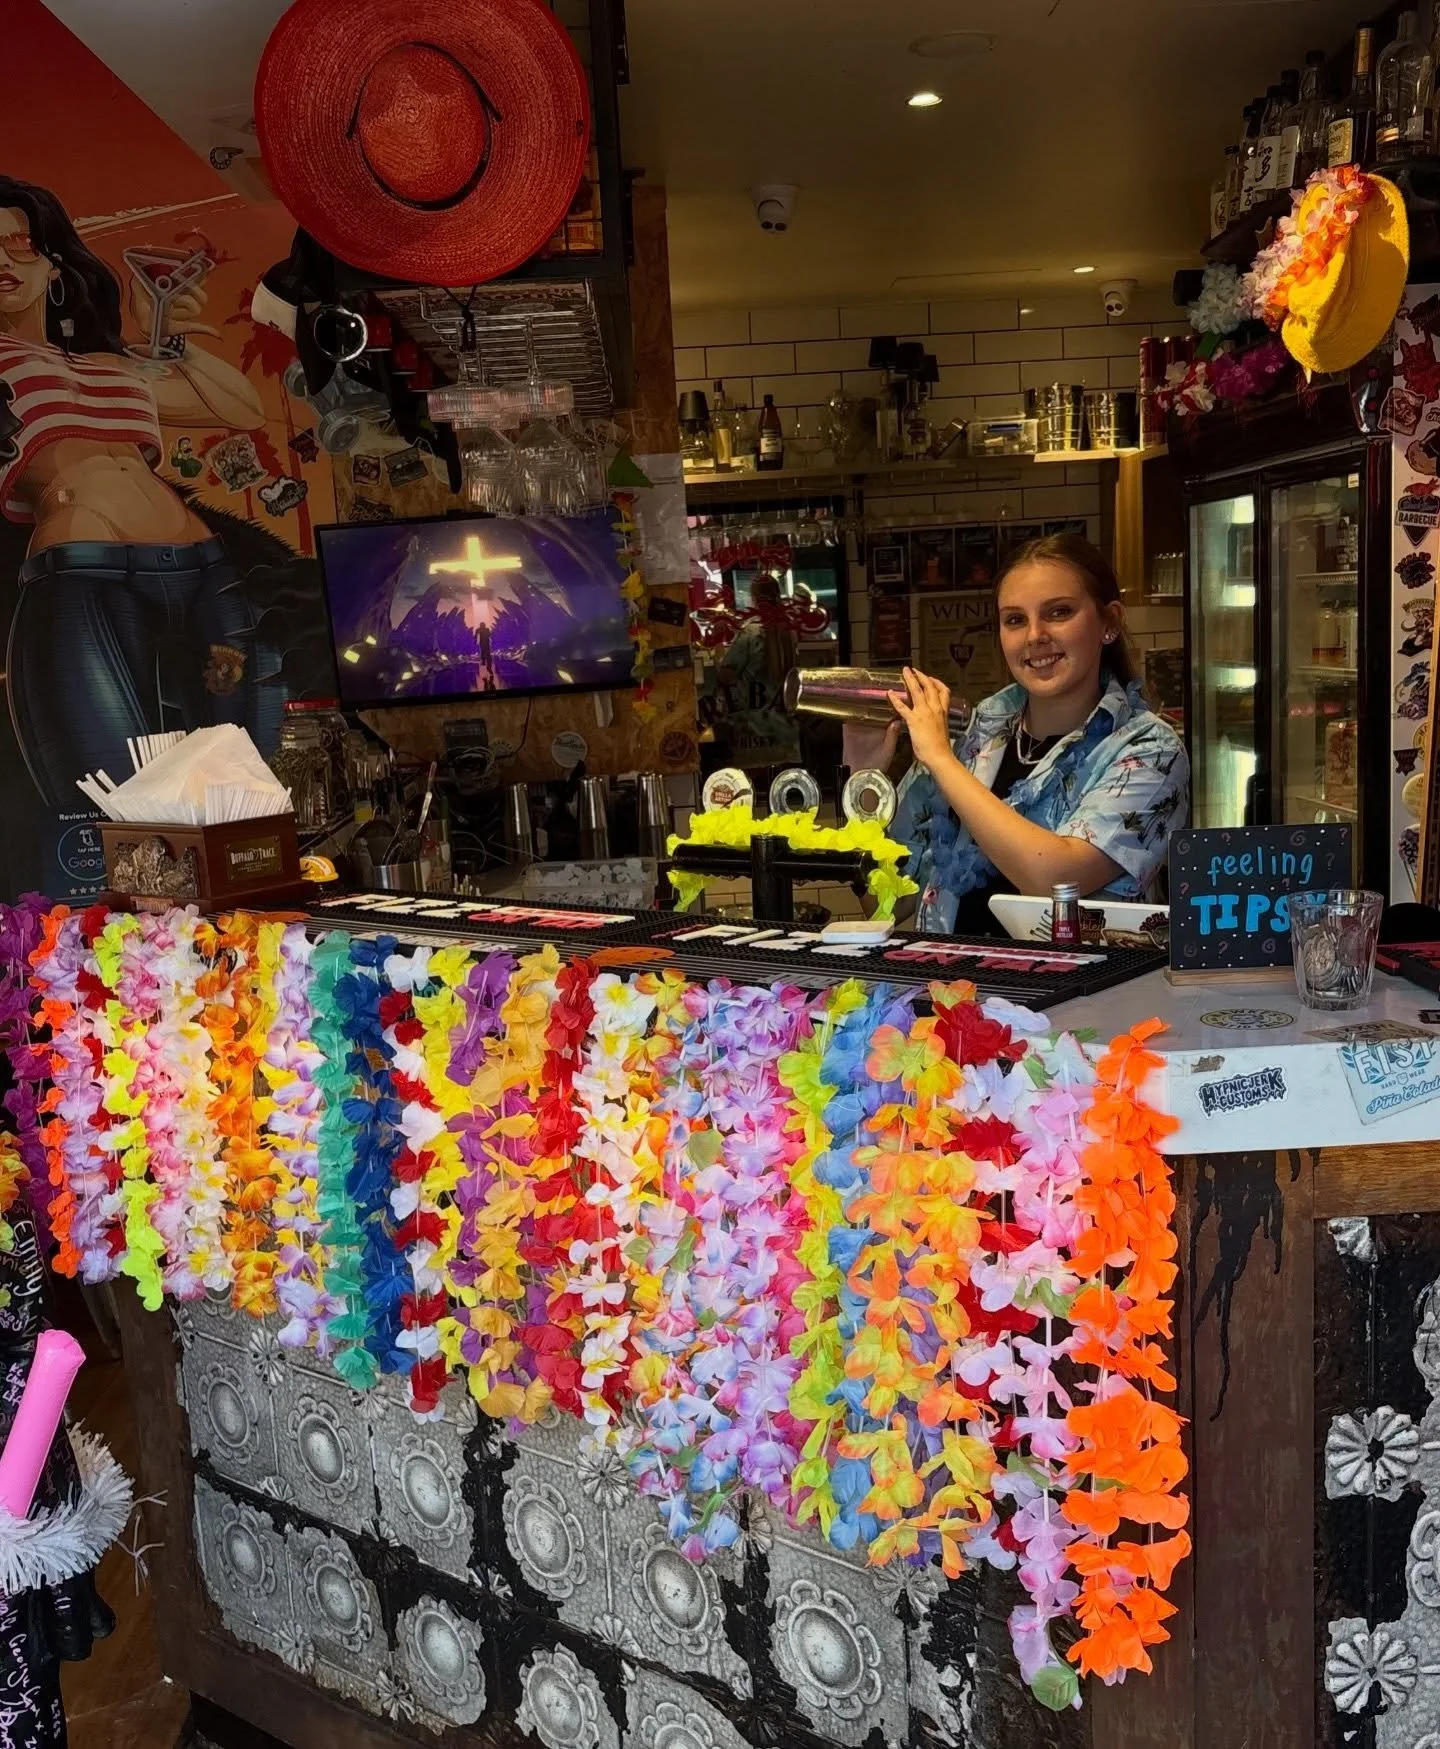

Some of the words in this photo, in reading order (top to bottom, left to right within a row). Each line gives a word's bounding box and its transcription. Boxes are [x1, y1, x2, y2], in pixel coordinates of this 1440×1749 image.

[1398, 511, 1437, 526] BARBECUE
[59, 813, 87, 821] Review
[68, 854, 105, 869] Googl
[230, 850, 254, 865] BUFFALO
[258, 847, 276, 860] TRACE
[1207, 846, 1313, 886] feeling
[320, 894, 501, 919] FIZZ
[882, 949, 967, 966] ON
[975, 955, 1081, 974] TAP
[1409, 1069, 1426, 1079] WEAR
[1220, 1091, 1269, 1106] CUSTOMS
[1366, 1093, 1402, 1115] Piña
